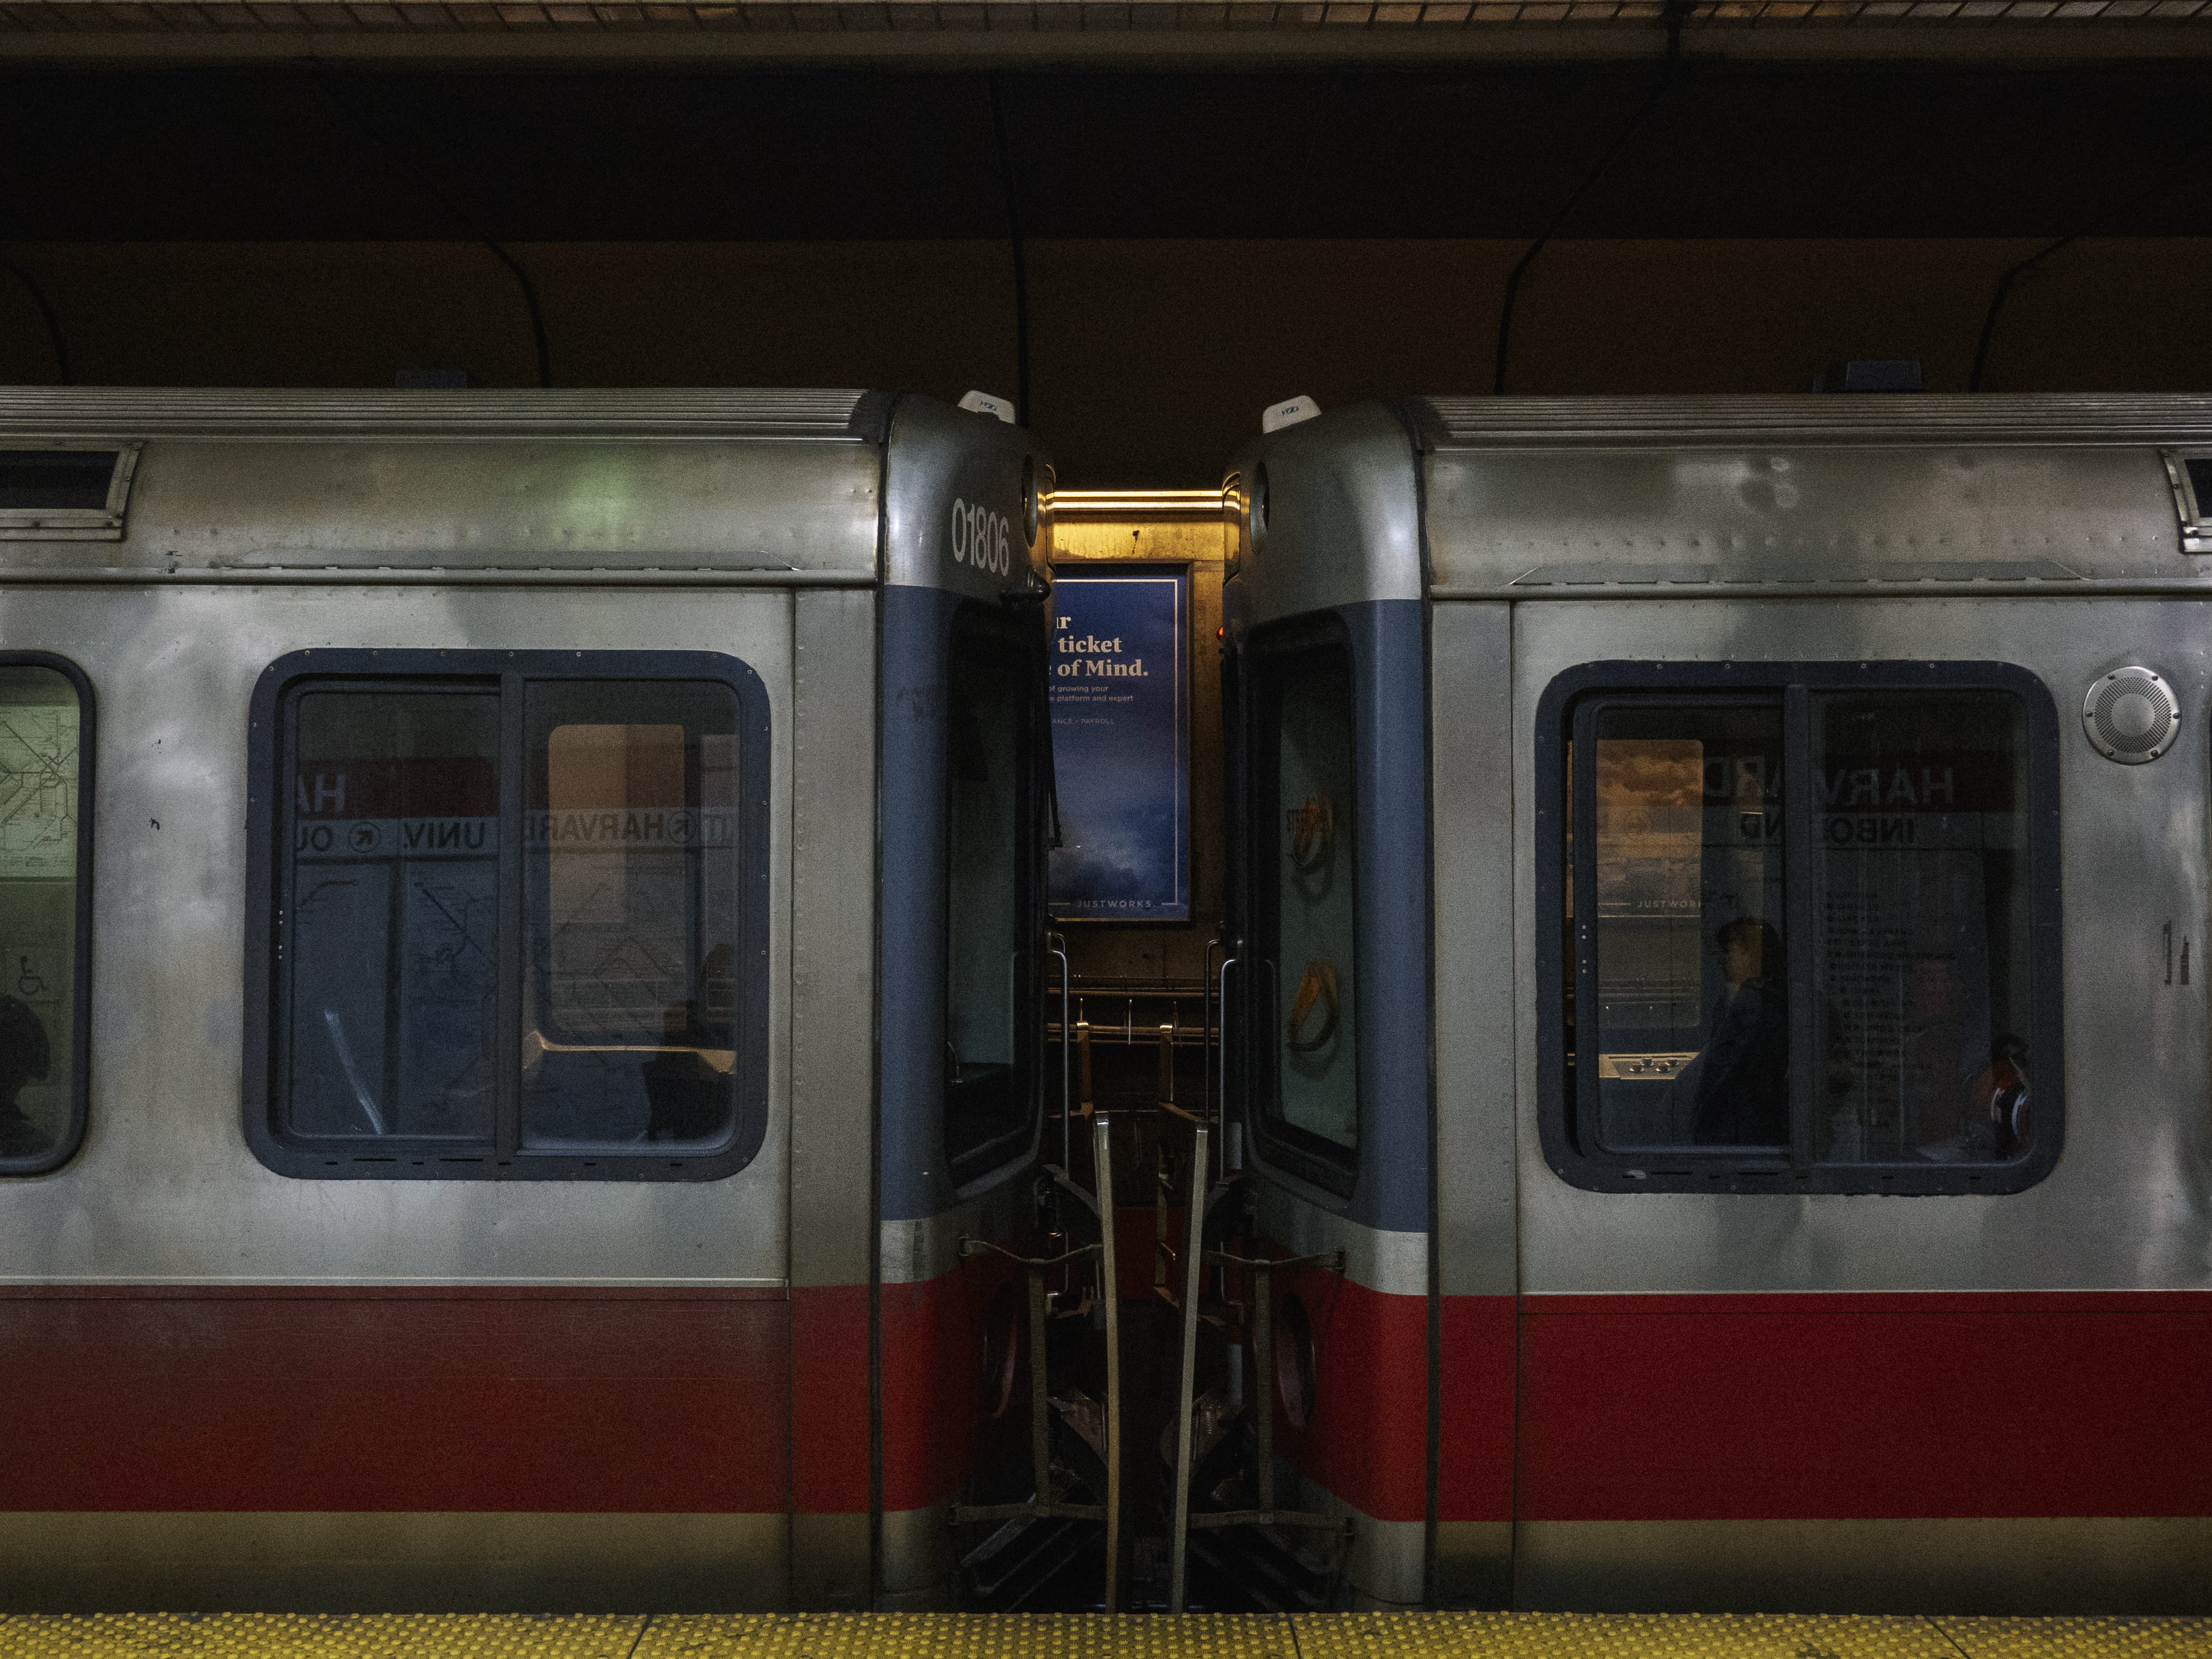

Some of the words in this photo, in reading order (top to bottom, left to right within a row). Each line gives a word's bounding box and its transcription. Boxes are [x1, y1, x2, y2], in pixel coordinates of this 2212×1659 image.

[952, 498, 1009, 576] 01806
[1058, 635, 1122, 653] ticket
[1057, 659, 1082, 677] of
[1085, 659, 1148, 677] Mind.
